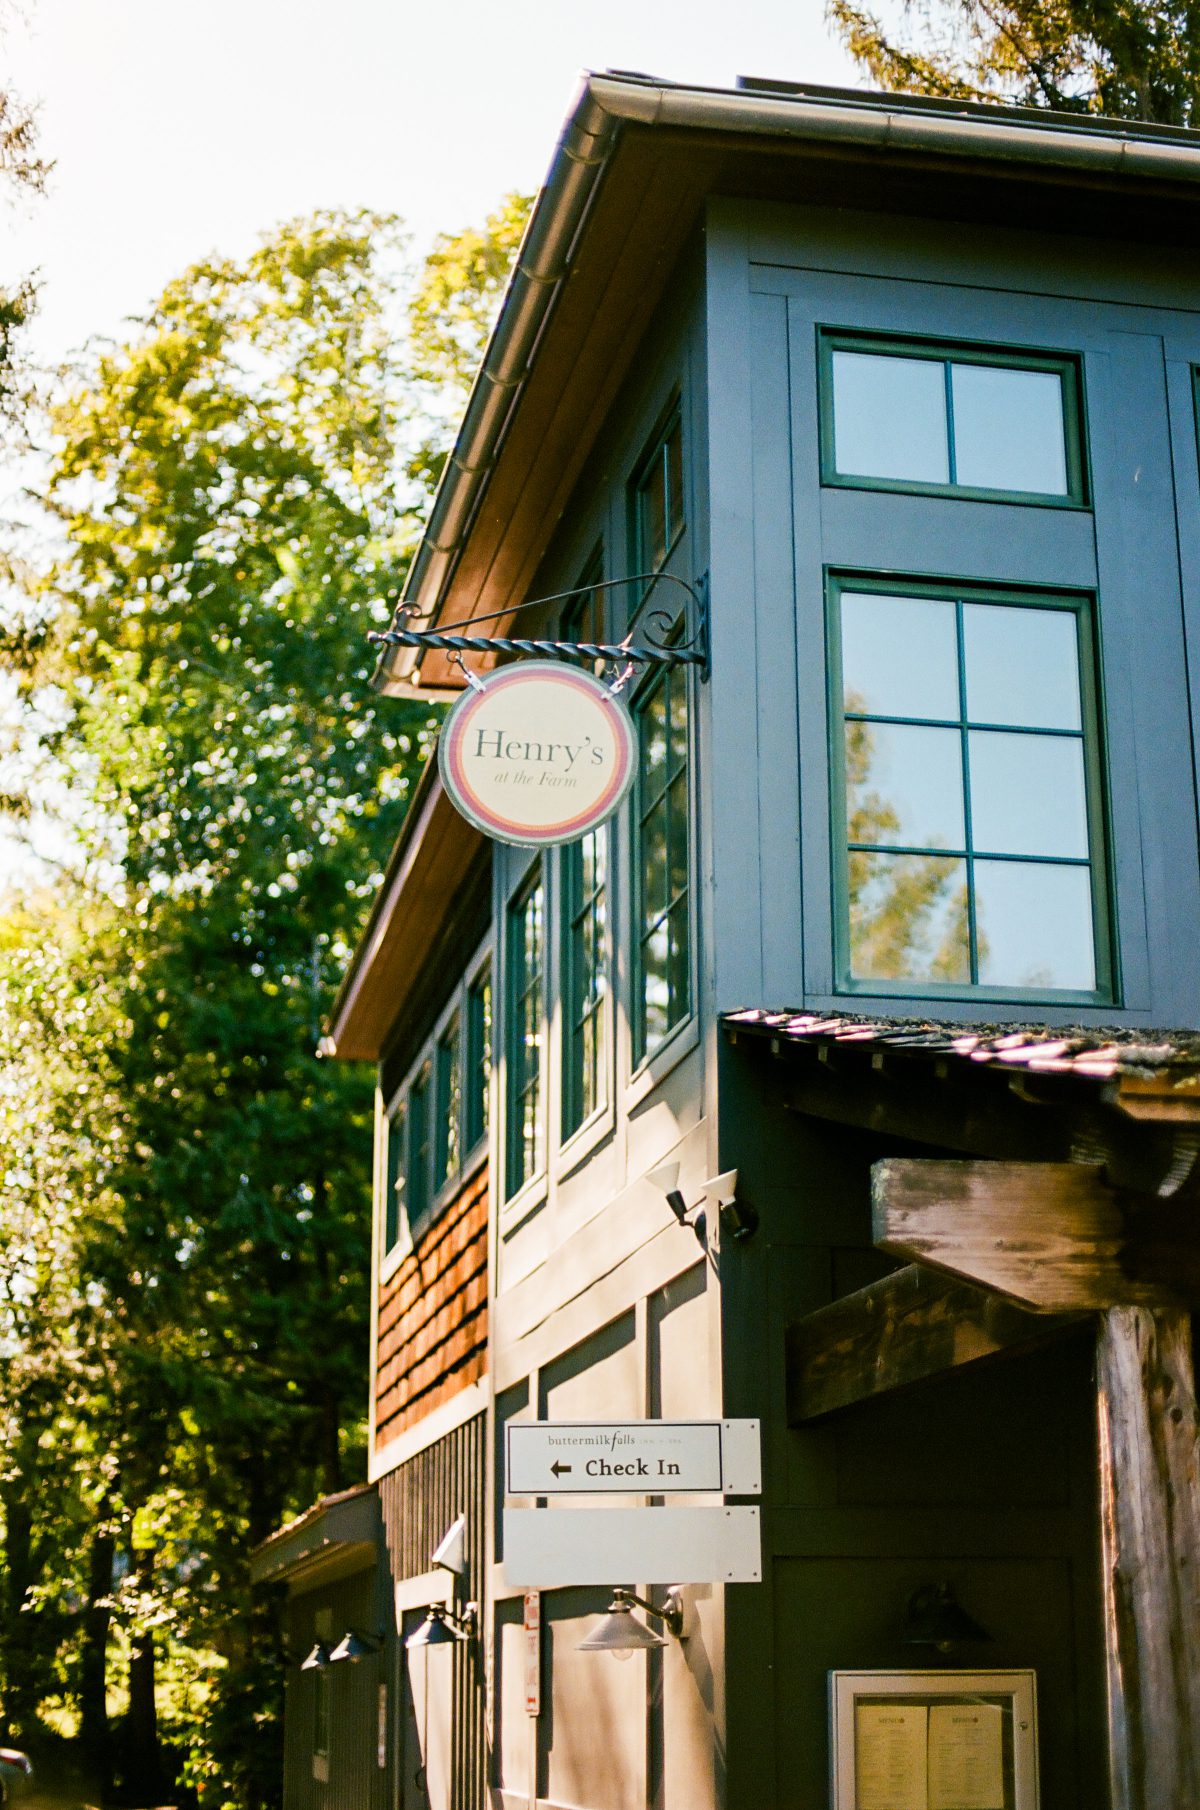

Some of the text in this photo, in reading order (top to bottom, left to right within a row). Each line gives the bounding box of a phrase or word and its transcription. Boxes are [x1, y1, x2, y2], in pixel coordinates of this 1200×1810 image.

[473, 729, 604, 772] Henry’s
[493, 769, 578, 788] at the Farm
[585, 1457, 681, 1477] Check In
